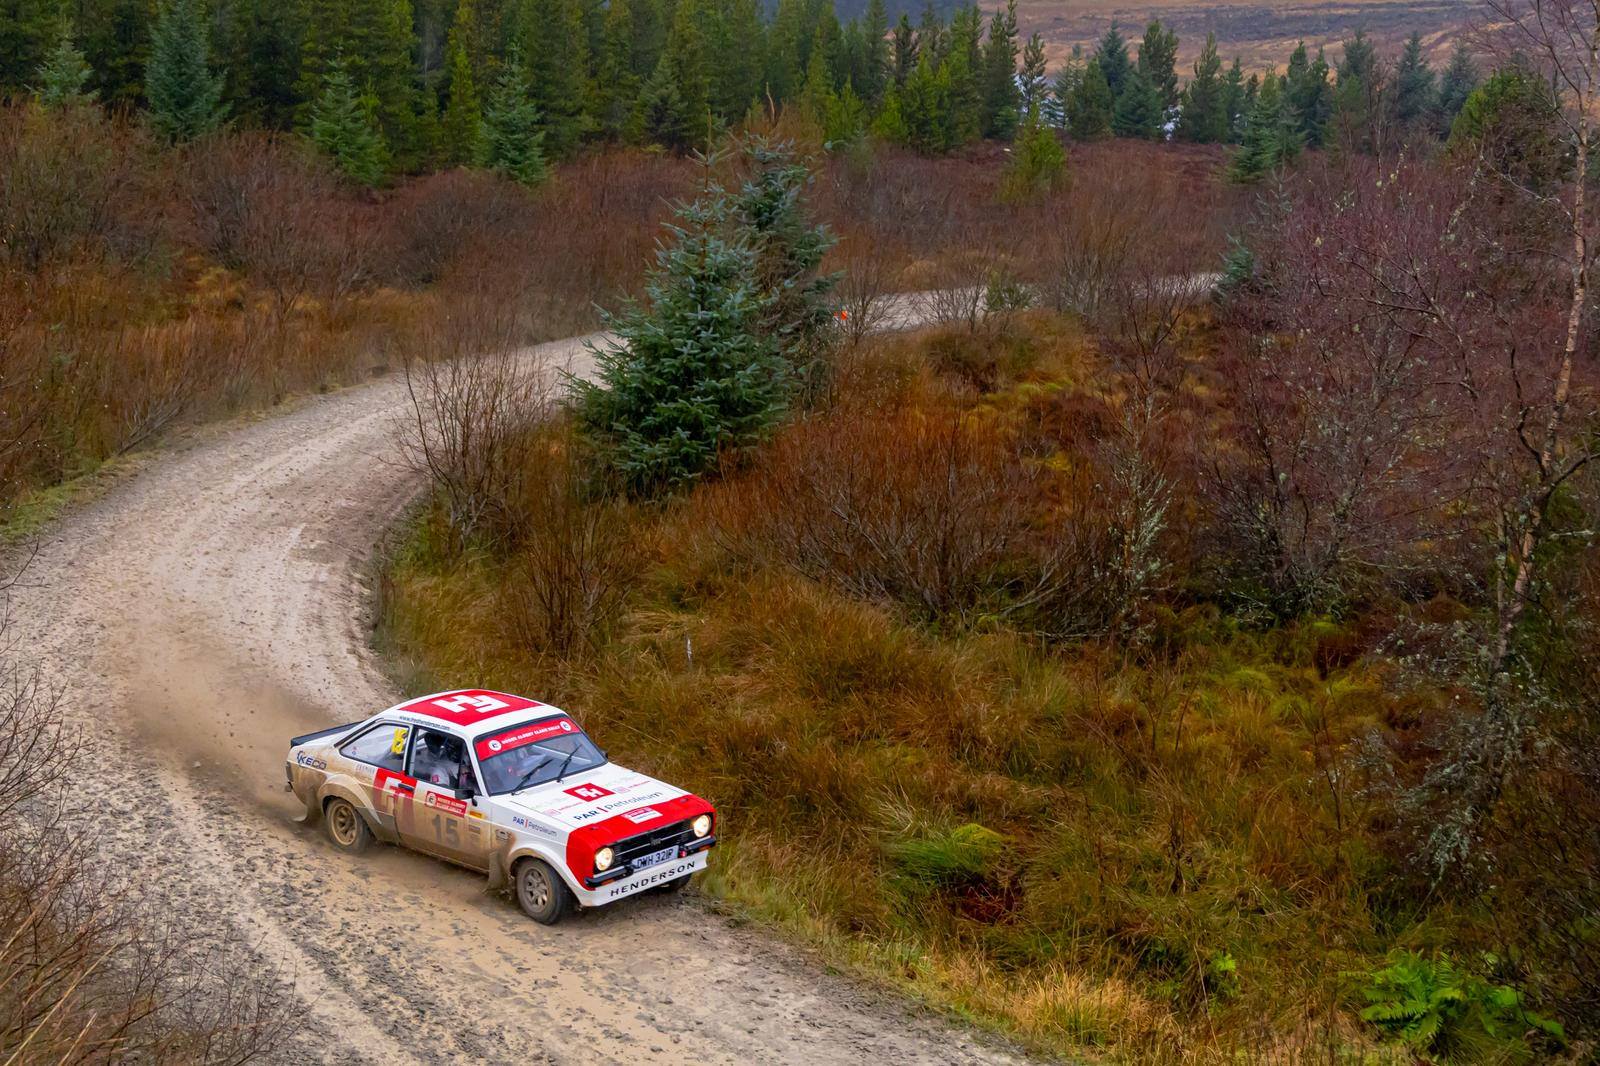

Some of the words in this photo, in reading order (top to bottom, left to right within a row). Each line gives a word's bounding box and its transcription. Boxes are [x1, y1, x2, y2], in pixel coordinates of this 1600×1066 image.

[299, 754, 327, 770] KECO
[573, 809, 598, 821] PAR
[604, 791, 663, 811] Petroleum
[431, 813, 460, 849] 15
[513, 816, 524, 825] PAR
[528, 821, 557, 837] Petroleum
[610, 860, 696, 897] HENDERSON
